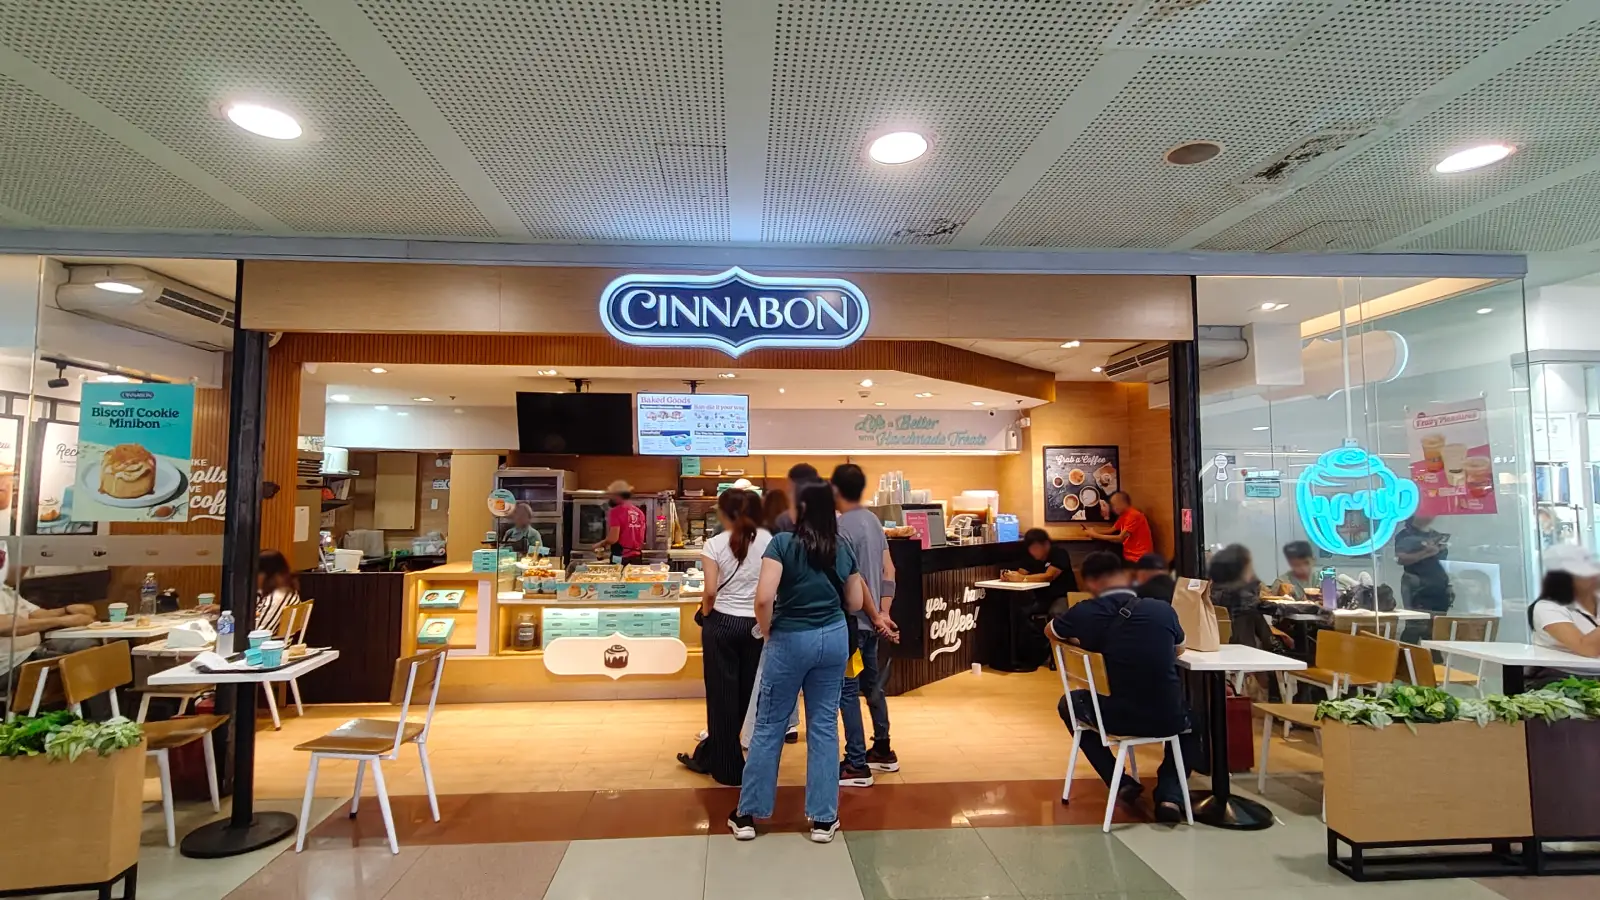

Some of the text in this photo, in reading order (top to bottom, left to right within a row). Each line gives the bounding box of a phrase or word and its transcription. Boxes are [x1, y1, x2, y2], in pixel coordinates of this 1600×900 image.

[620, 289, 850, 330] CINNABON
[641, 396, 665, 404] Baked
[91, 407, 180, 418] Biscoff Cookie
[108, 418, 161, 429] Minibon
[895, 415, 940, 430] Better
[876, 431, 946, 446] Handmade
[947, 430, 987, 446] Treats
[56, 442, 80, 459] Rec
[1055, 454, 1075, 465] Grab
[1081, 455, 1106, 466] Coffee
[926, 597, 947, 619] yes,
[963, 586, 987, 603] have
[930, 606, 981, 645] coffee!
